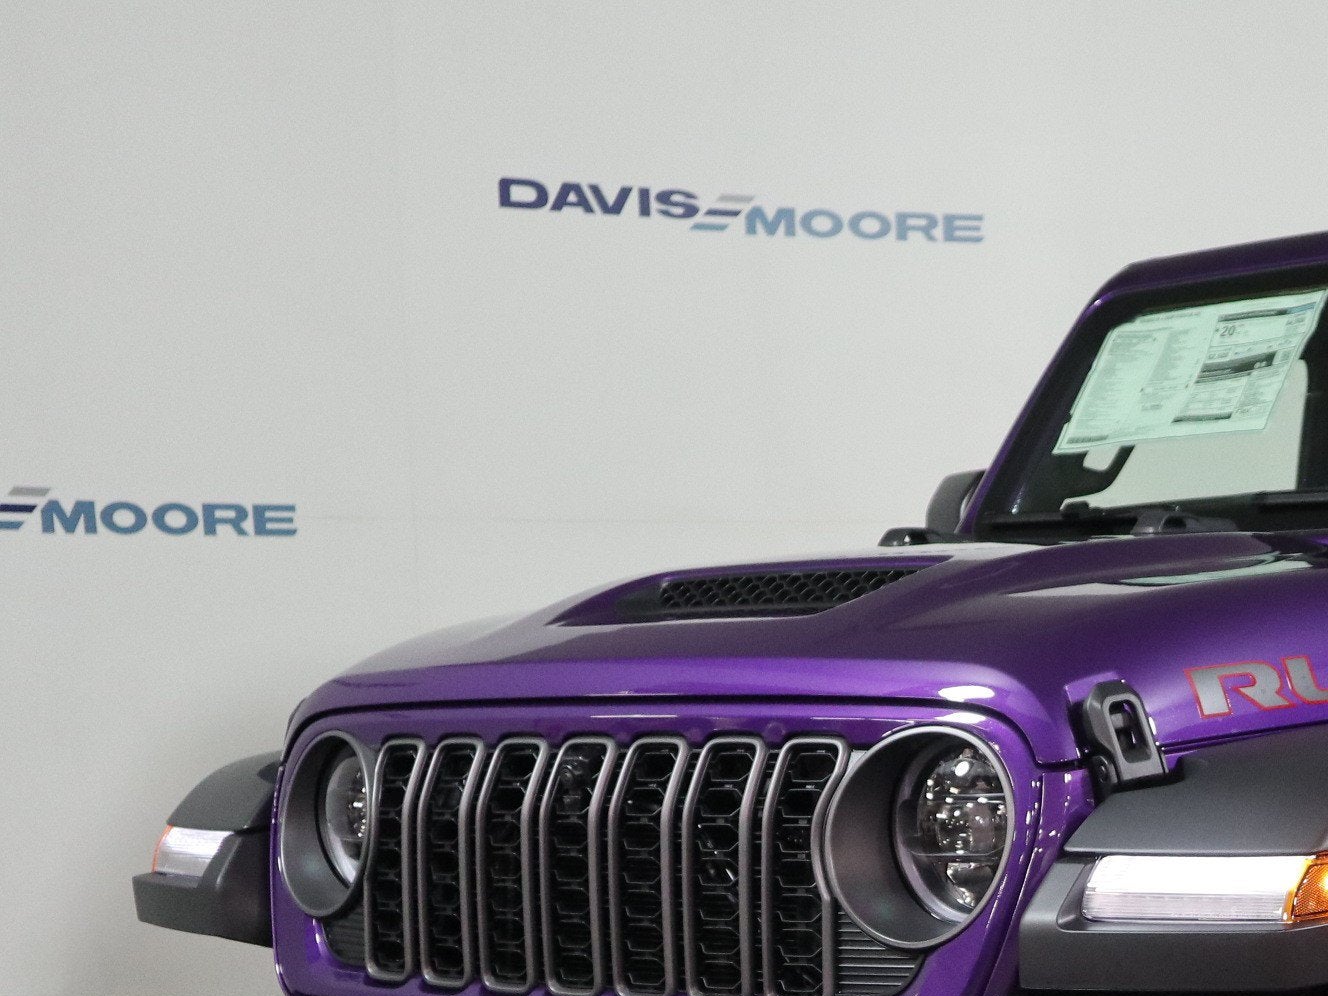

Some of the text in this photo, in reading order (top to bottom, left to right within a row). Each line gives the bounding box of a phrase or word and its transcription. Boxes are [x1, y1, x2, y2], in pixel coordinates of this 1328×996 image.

[499, 177, 984, 243] DAVIS MOORE
[41, 499, 297, 536] MOORE
